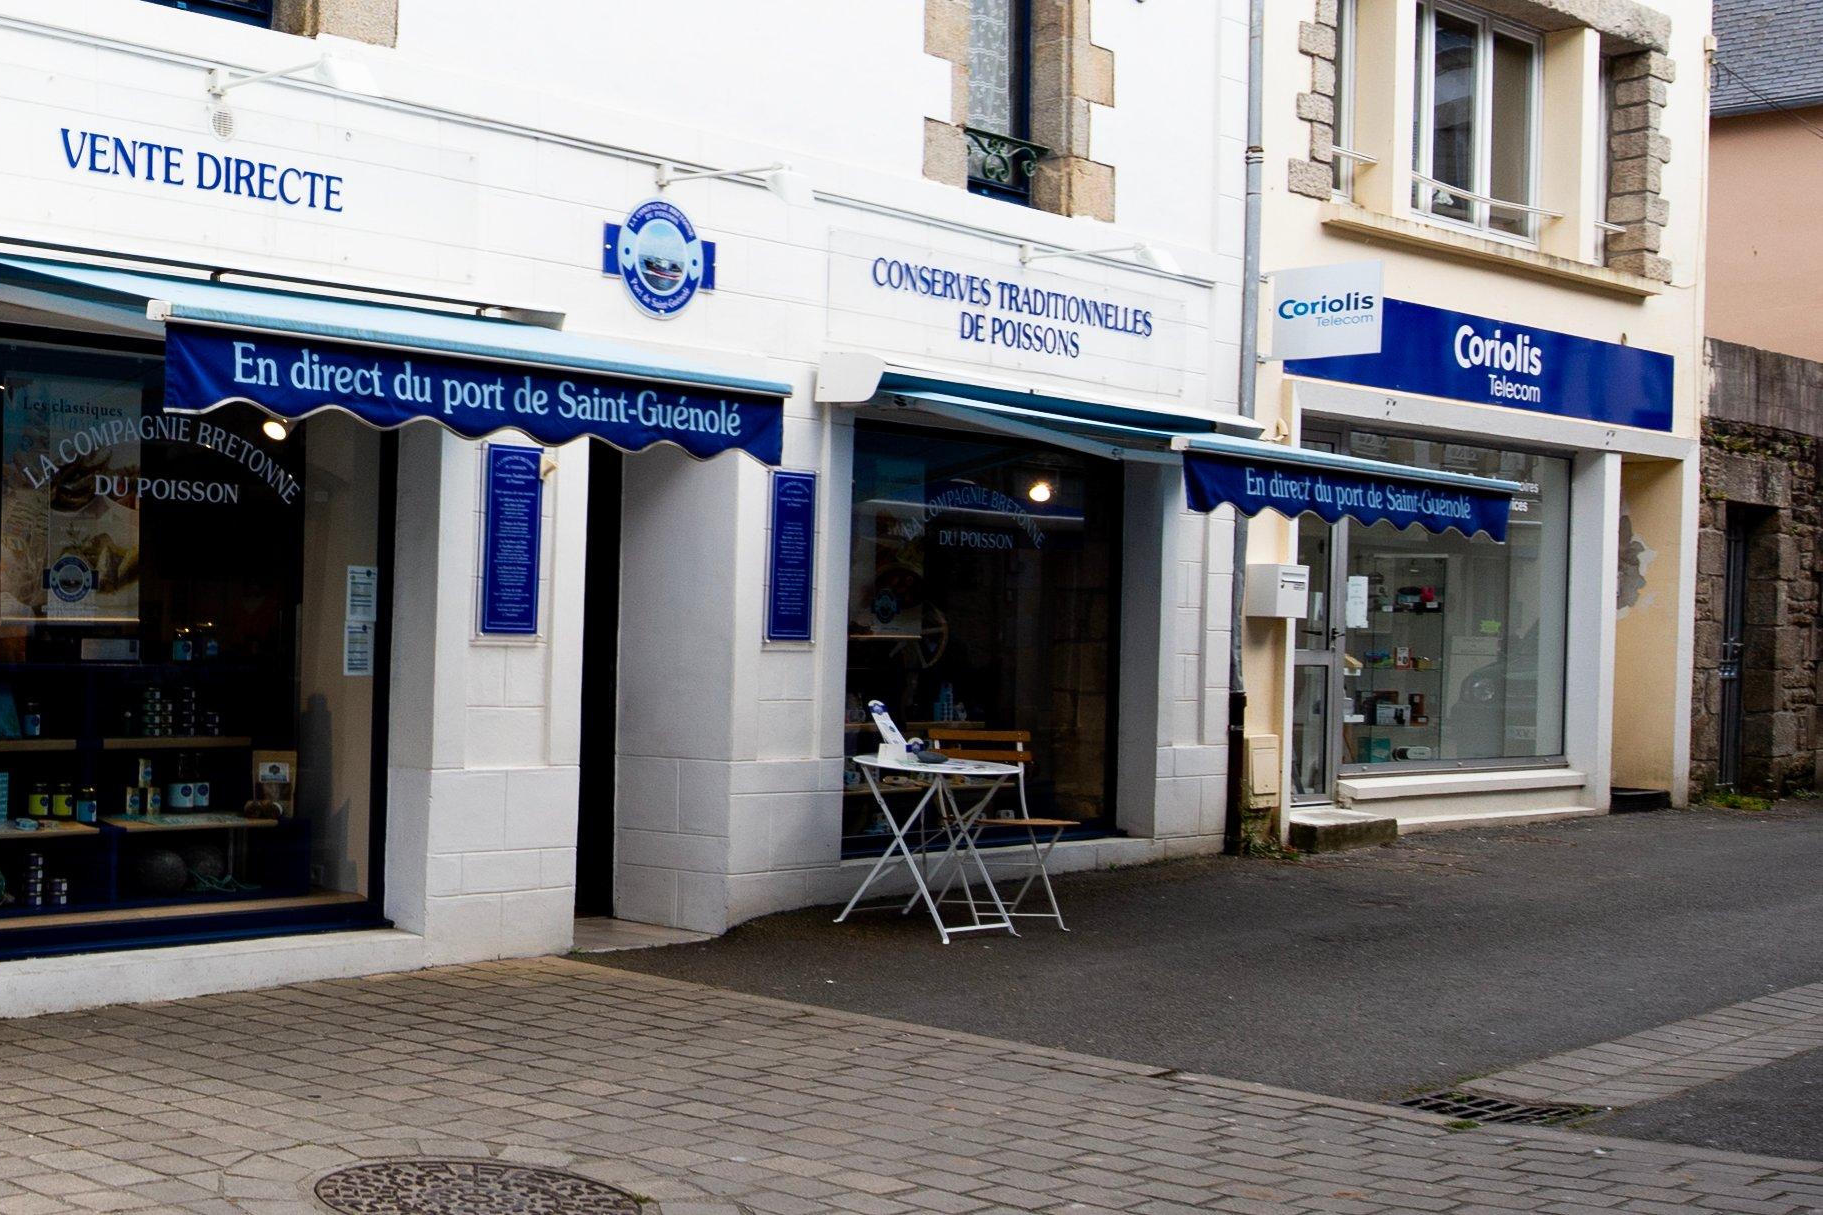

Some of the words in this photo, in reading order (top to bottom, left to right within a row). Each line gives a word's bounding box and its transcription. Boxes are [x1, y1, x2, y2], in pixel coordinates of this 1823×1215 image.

[60, 127, 184, 186] VENTE
[197, 152, 344, 213] DIRECTE
[872, 256, 991, 308] CONSERVES
[996, 281, 1153, 337] TRADITIONNELLES
[1278, 291, 1374, 320] Coriolis
[1316, 314, 1374, 327] Telecom
[960, 311, 986, 343] DE
[991, 317, 1080, 359] POISSONS
[1454, 324, 1543, 376] Coriolis
[23, 396, 48, 412] Les
[50, 398, 124, 419] classiques
[233, 341, 279, 386] En
[290, 348, 385, 397] direct
[394, 360, 432, 403] du
[442, 377, 505, 414] port
[513, 376, 549, 415] de
[558, 381, 741, 436] Saint-Guénolé
[1488, 373, 1541, 403] Telecom
[23, 453, 60, 490] LA
[58, 415, 191, 464] COMPAGNIE
[197, 421, 301, 505] BRETONNE
[94, 475, 128, 498] DU
[136, 477, 239, 504] POISSON
[1245, 467, 1266, 496] En
[1269, 471, 1311, 501] direct
[1315, 476, 1332, 503] du
[1336, 483, 1364, 511] port
[1367, 483, 1383, 509] de
[1386, 485, 1472, 520] Saint-Guénolé
[939, 530, 957, 546] DU
[960, 531, 1014, 549] POISSON
